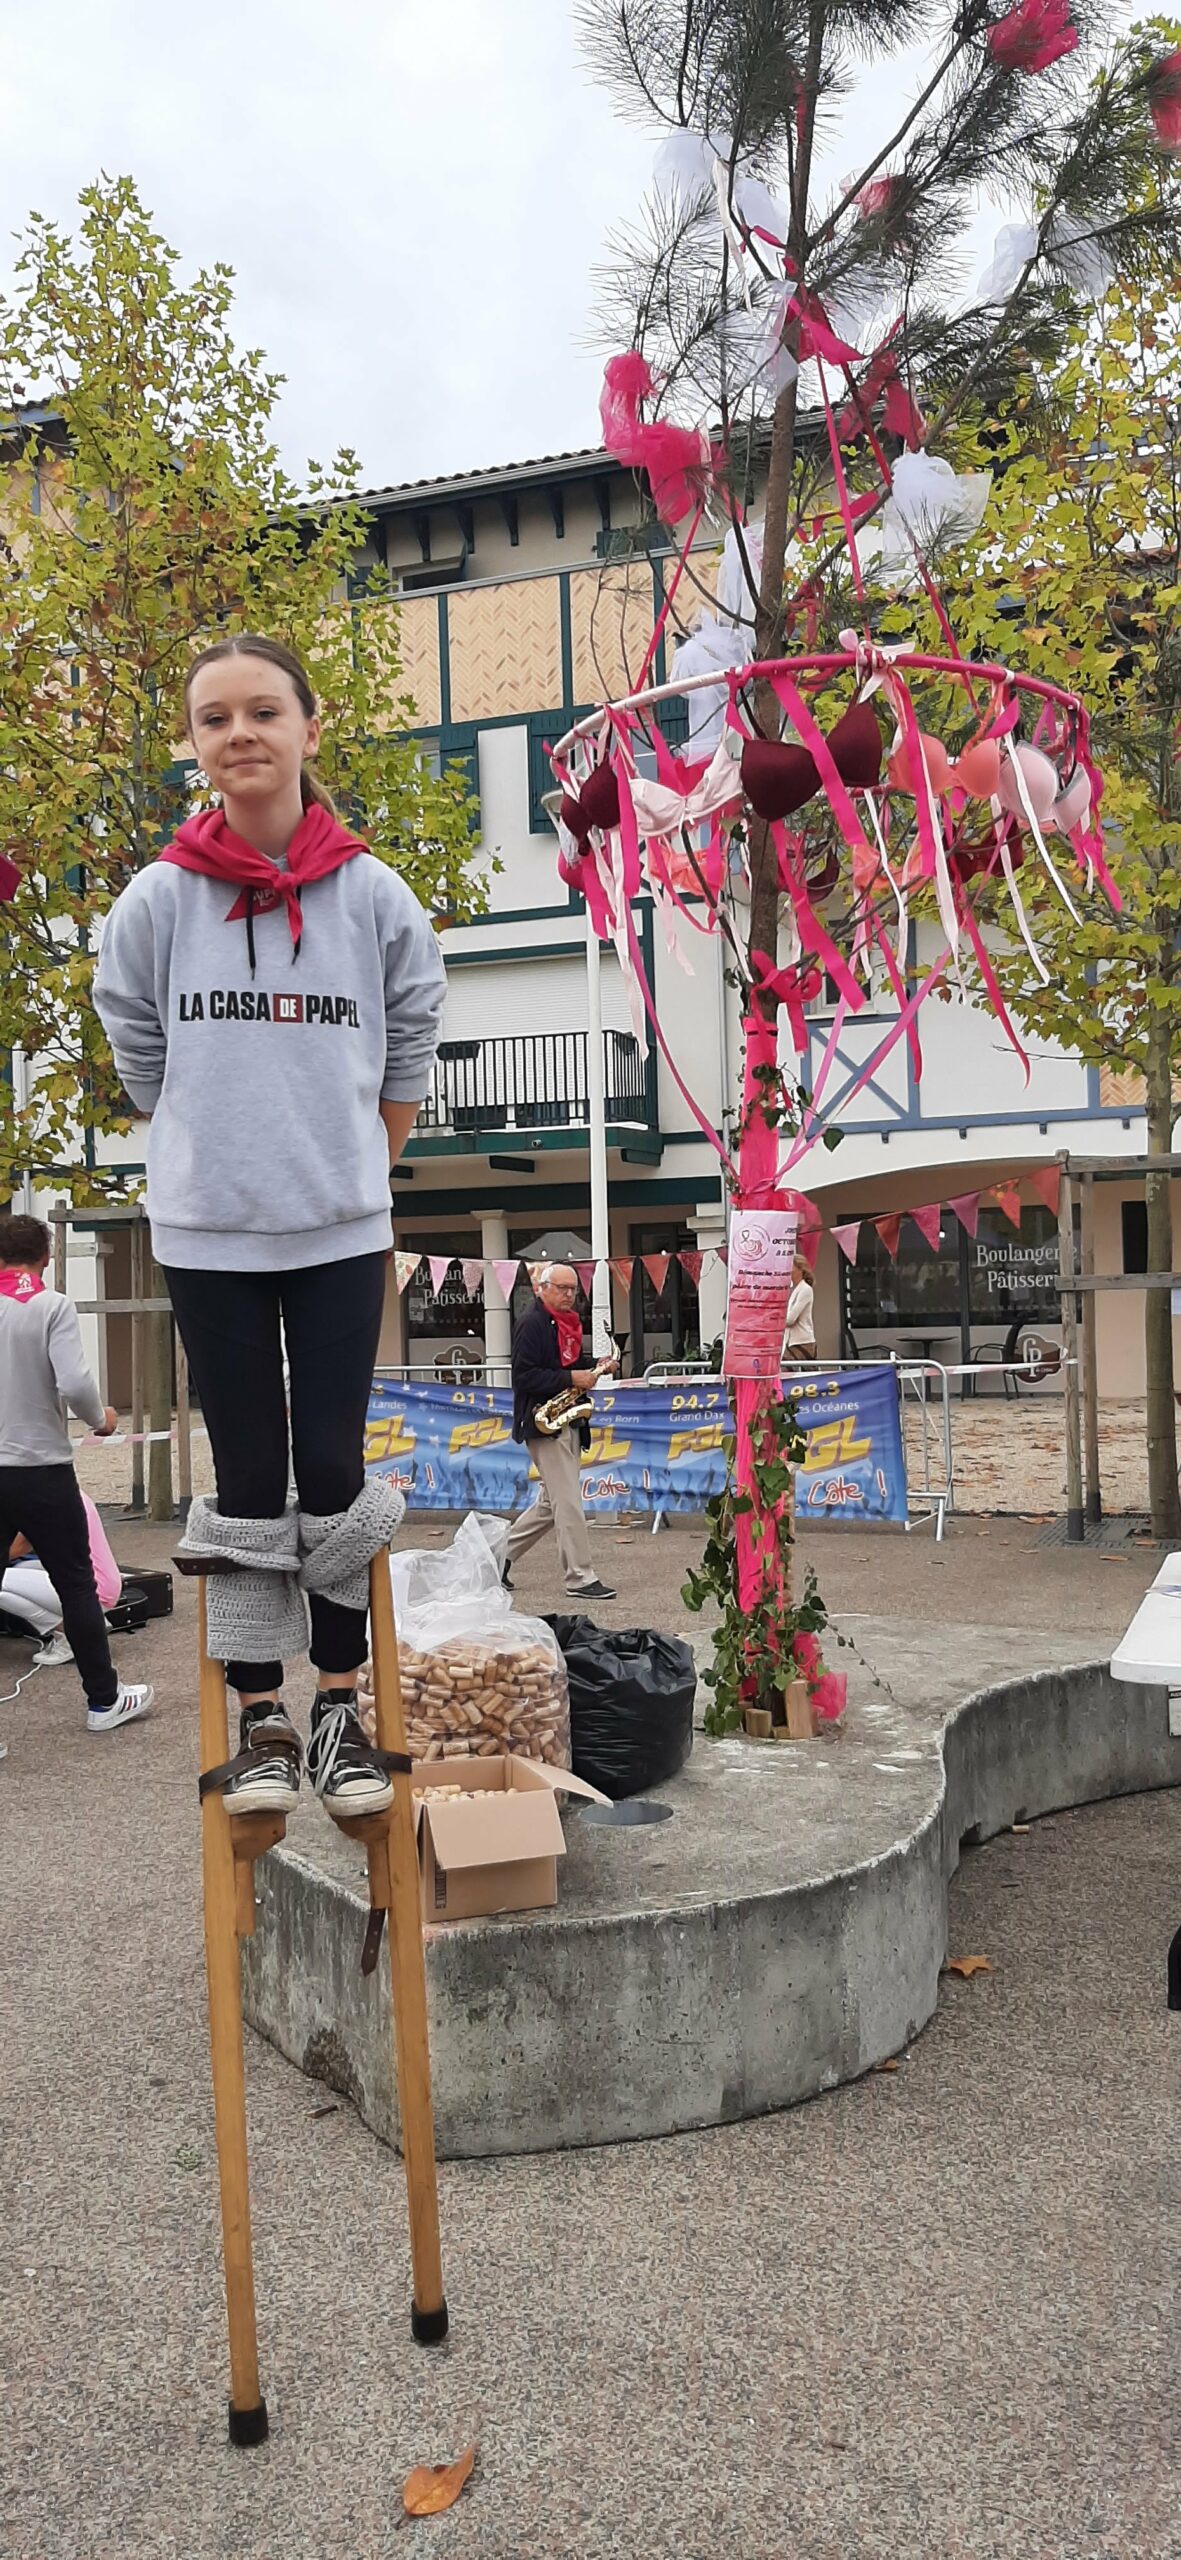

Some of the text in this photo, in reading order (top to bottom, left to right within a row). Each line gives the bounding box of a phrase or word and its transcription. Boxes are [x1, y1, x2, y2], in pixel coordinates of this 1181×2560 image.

[179, 990, 360, 1029] LA CASA DE PAPEL
[976, 1243, 1078, 1266] Boulangere
[987, 1270, 1058, 1292] Pâtisser
[790, 1381, 840, 1399] 98.3
[372, 1401, 407, 1410] Landes
[671, 1393, 720, 1410] 94.7
[812, 1401, 860, 1413] Océanes
[615, 1415, 640, 1424] Born
[669, 1410, 725, 1422] Grand Dax
[790, 1415, 873, 1475] GL
[807, 1468, 888, 1508] Côte !
